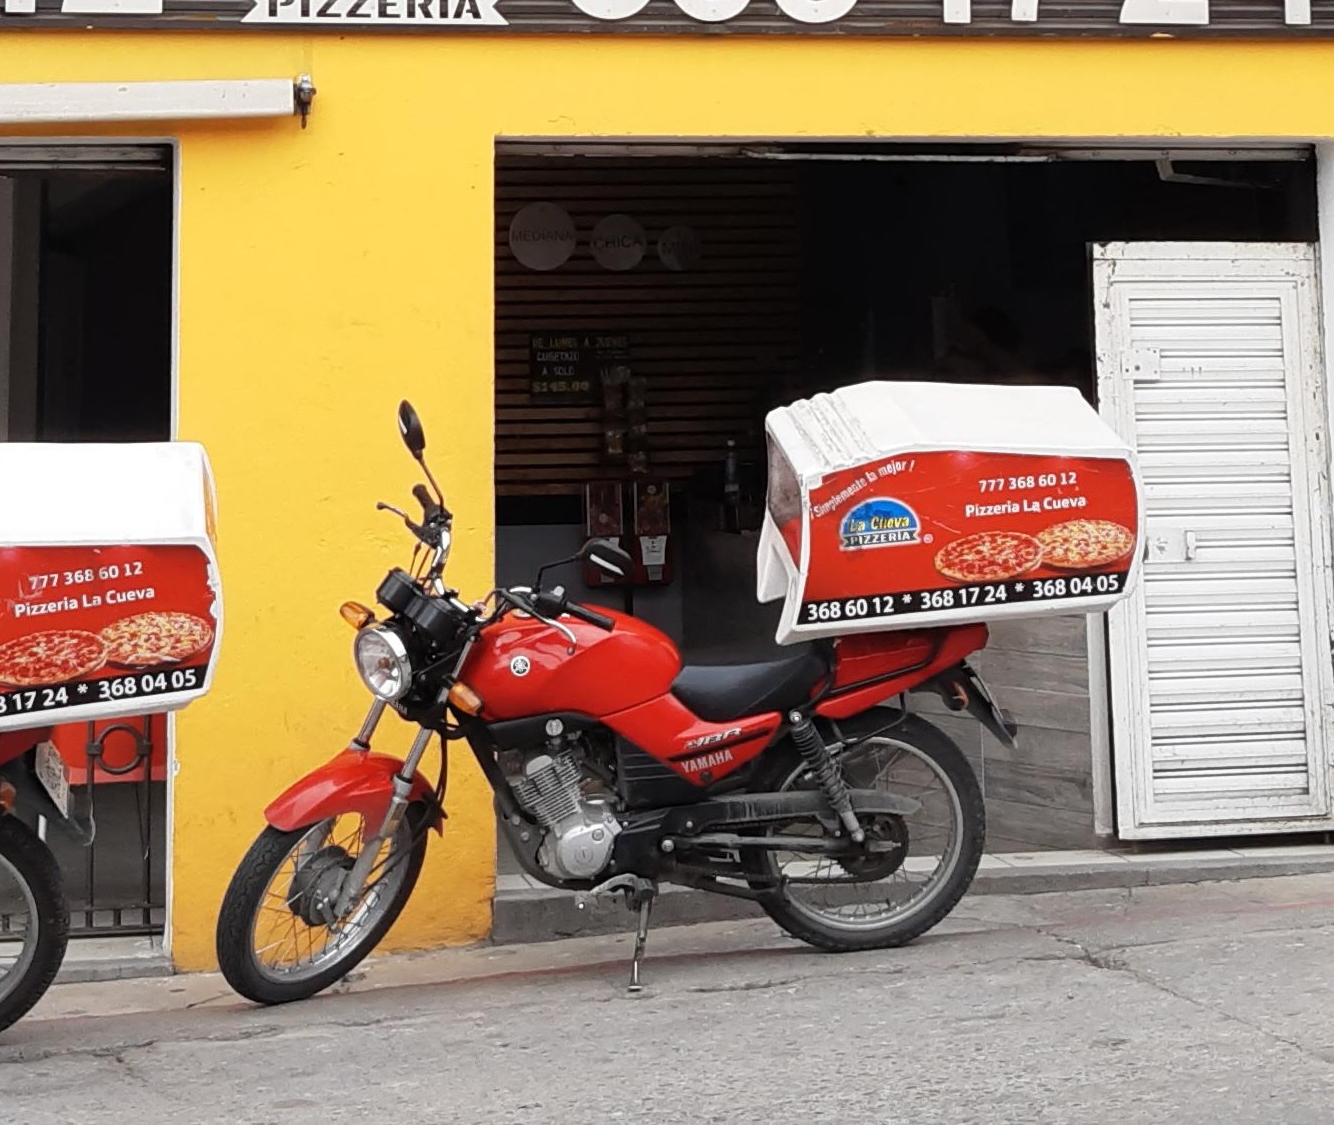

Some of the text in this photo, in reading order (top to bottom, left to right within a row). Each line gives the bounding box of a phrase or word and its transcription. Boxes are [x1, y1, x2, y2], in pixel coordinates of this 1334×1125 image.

[593, 235, 644, 249] CHICA
[979, 472, 1077, 493] 777 368 60 12
[965, 496, 1087, 517] Pizzeria La Cueva
[850, 516, 910, 532] La Cueva
[28, 561, 143, 590] 777 368 60 12
[14, 587, 156, 618] Pizzeria La Cueva
[807, 573, 1119, 621] 368 60 12 368 17 24 368 04 05
[12, 692, 36, 711] 17
[42, 686, 69, 707] 24
[98, 678, 137, 699] 368
[140, 673, 167, 692] 04
[171, 668, 197, 688] 05
[681, 750, 734, 774] YAMAHA
